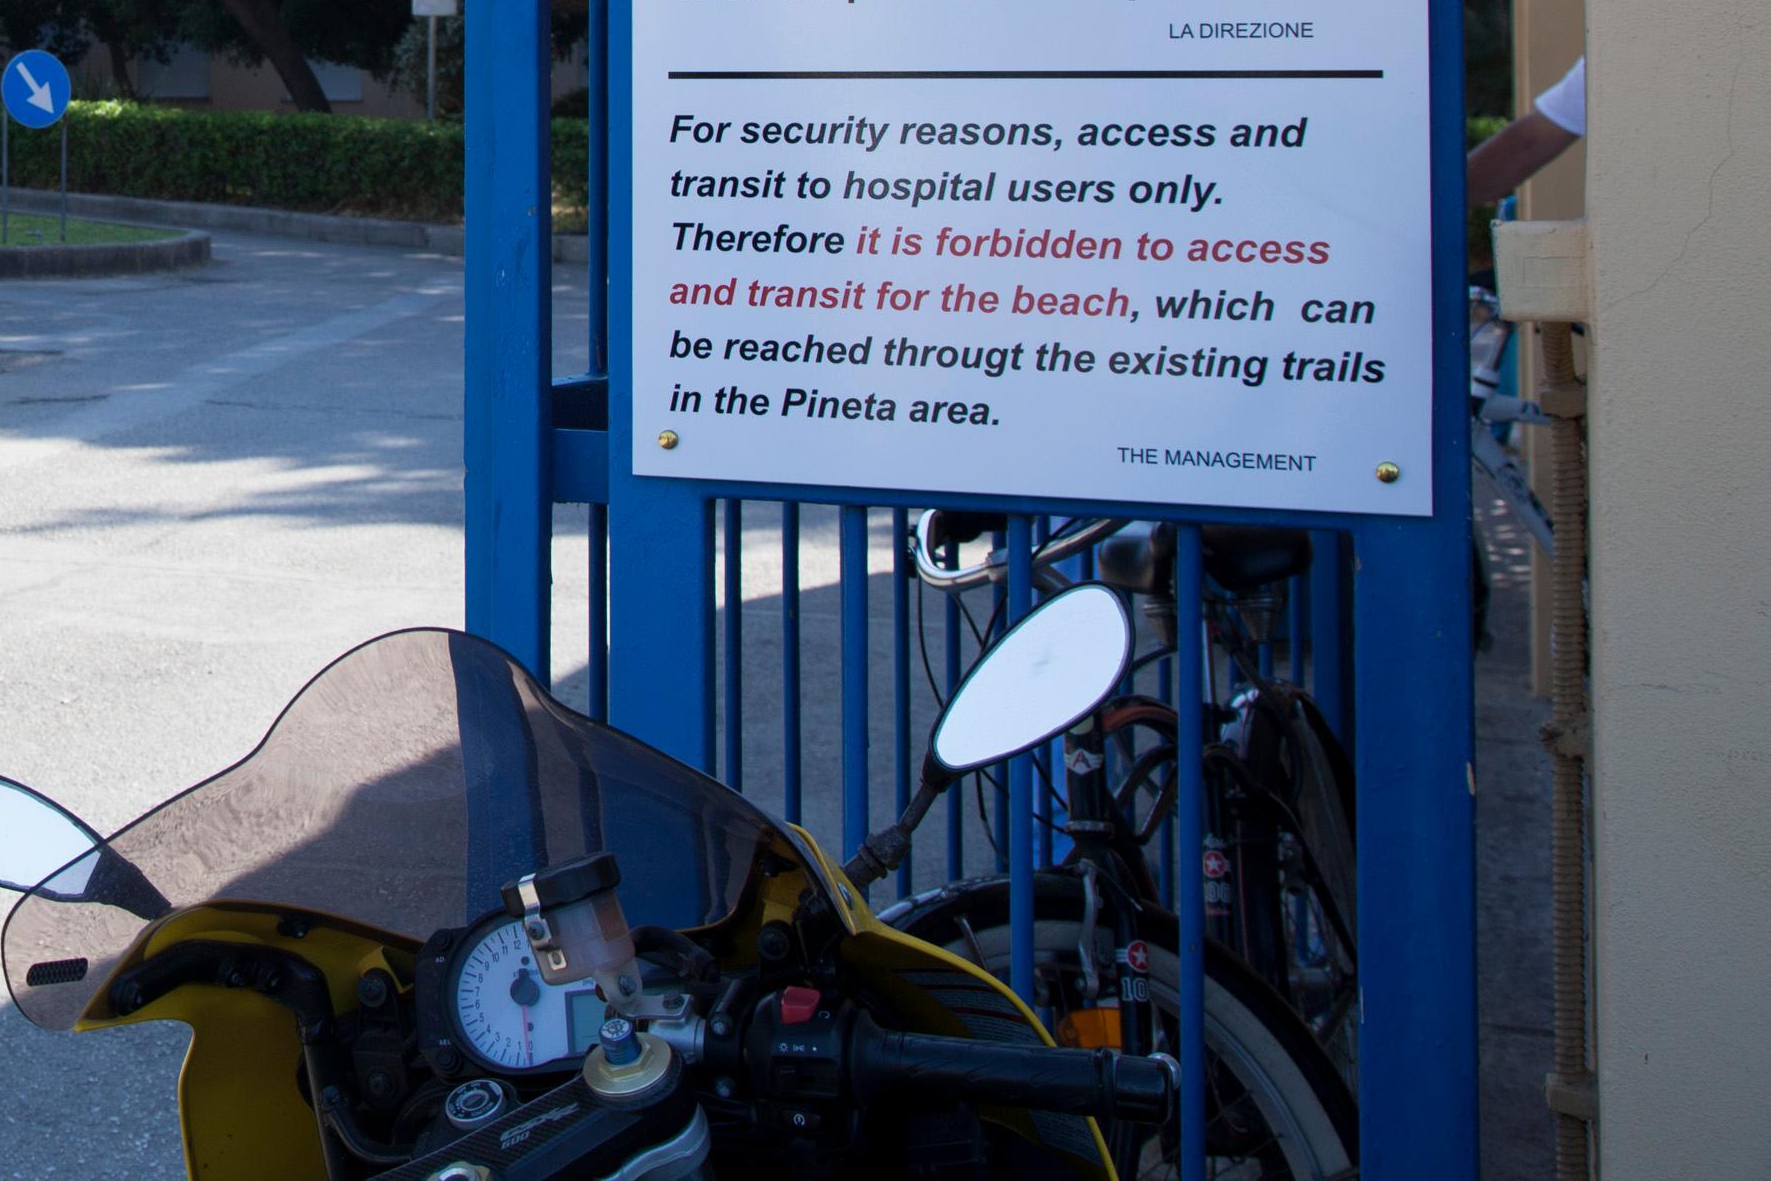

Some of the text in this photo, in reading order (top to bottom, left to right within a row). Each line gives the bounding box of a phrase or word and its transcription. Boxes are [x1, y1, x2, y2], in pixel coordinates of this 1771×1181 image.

[1170, 22, 1314, 39] LA DIREZIONE
[670, 115, 1308, 152] For security reasons, access and
[671, 169, 1222, 212] transit to hospital users only.
[673, 222, 1330, 264] Therefore it is forbidden to access
[670, 278, 1376, 324] and transit for the beach, which can
[670, 330, 1386, 387] be reached througt the existing trails
[670, 384, 999, 425] in the Pineta area.
[1117, 447, 1316, 472] THE MANAGEMENT
